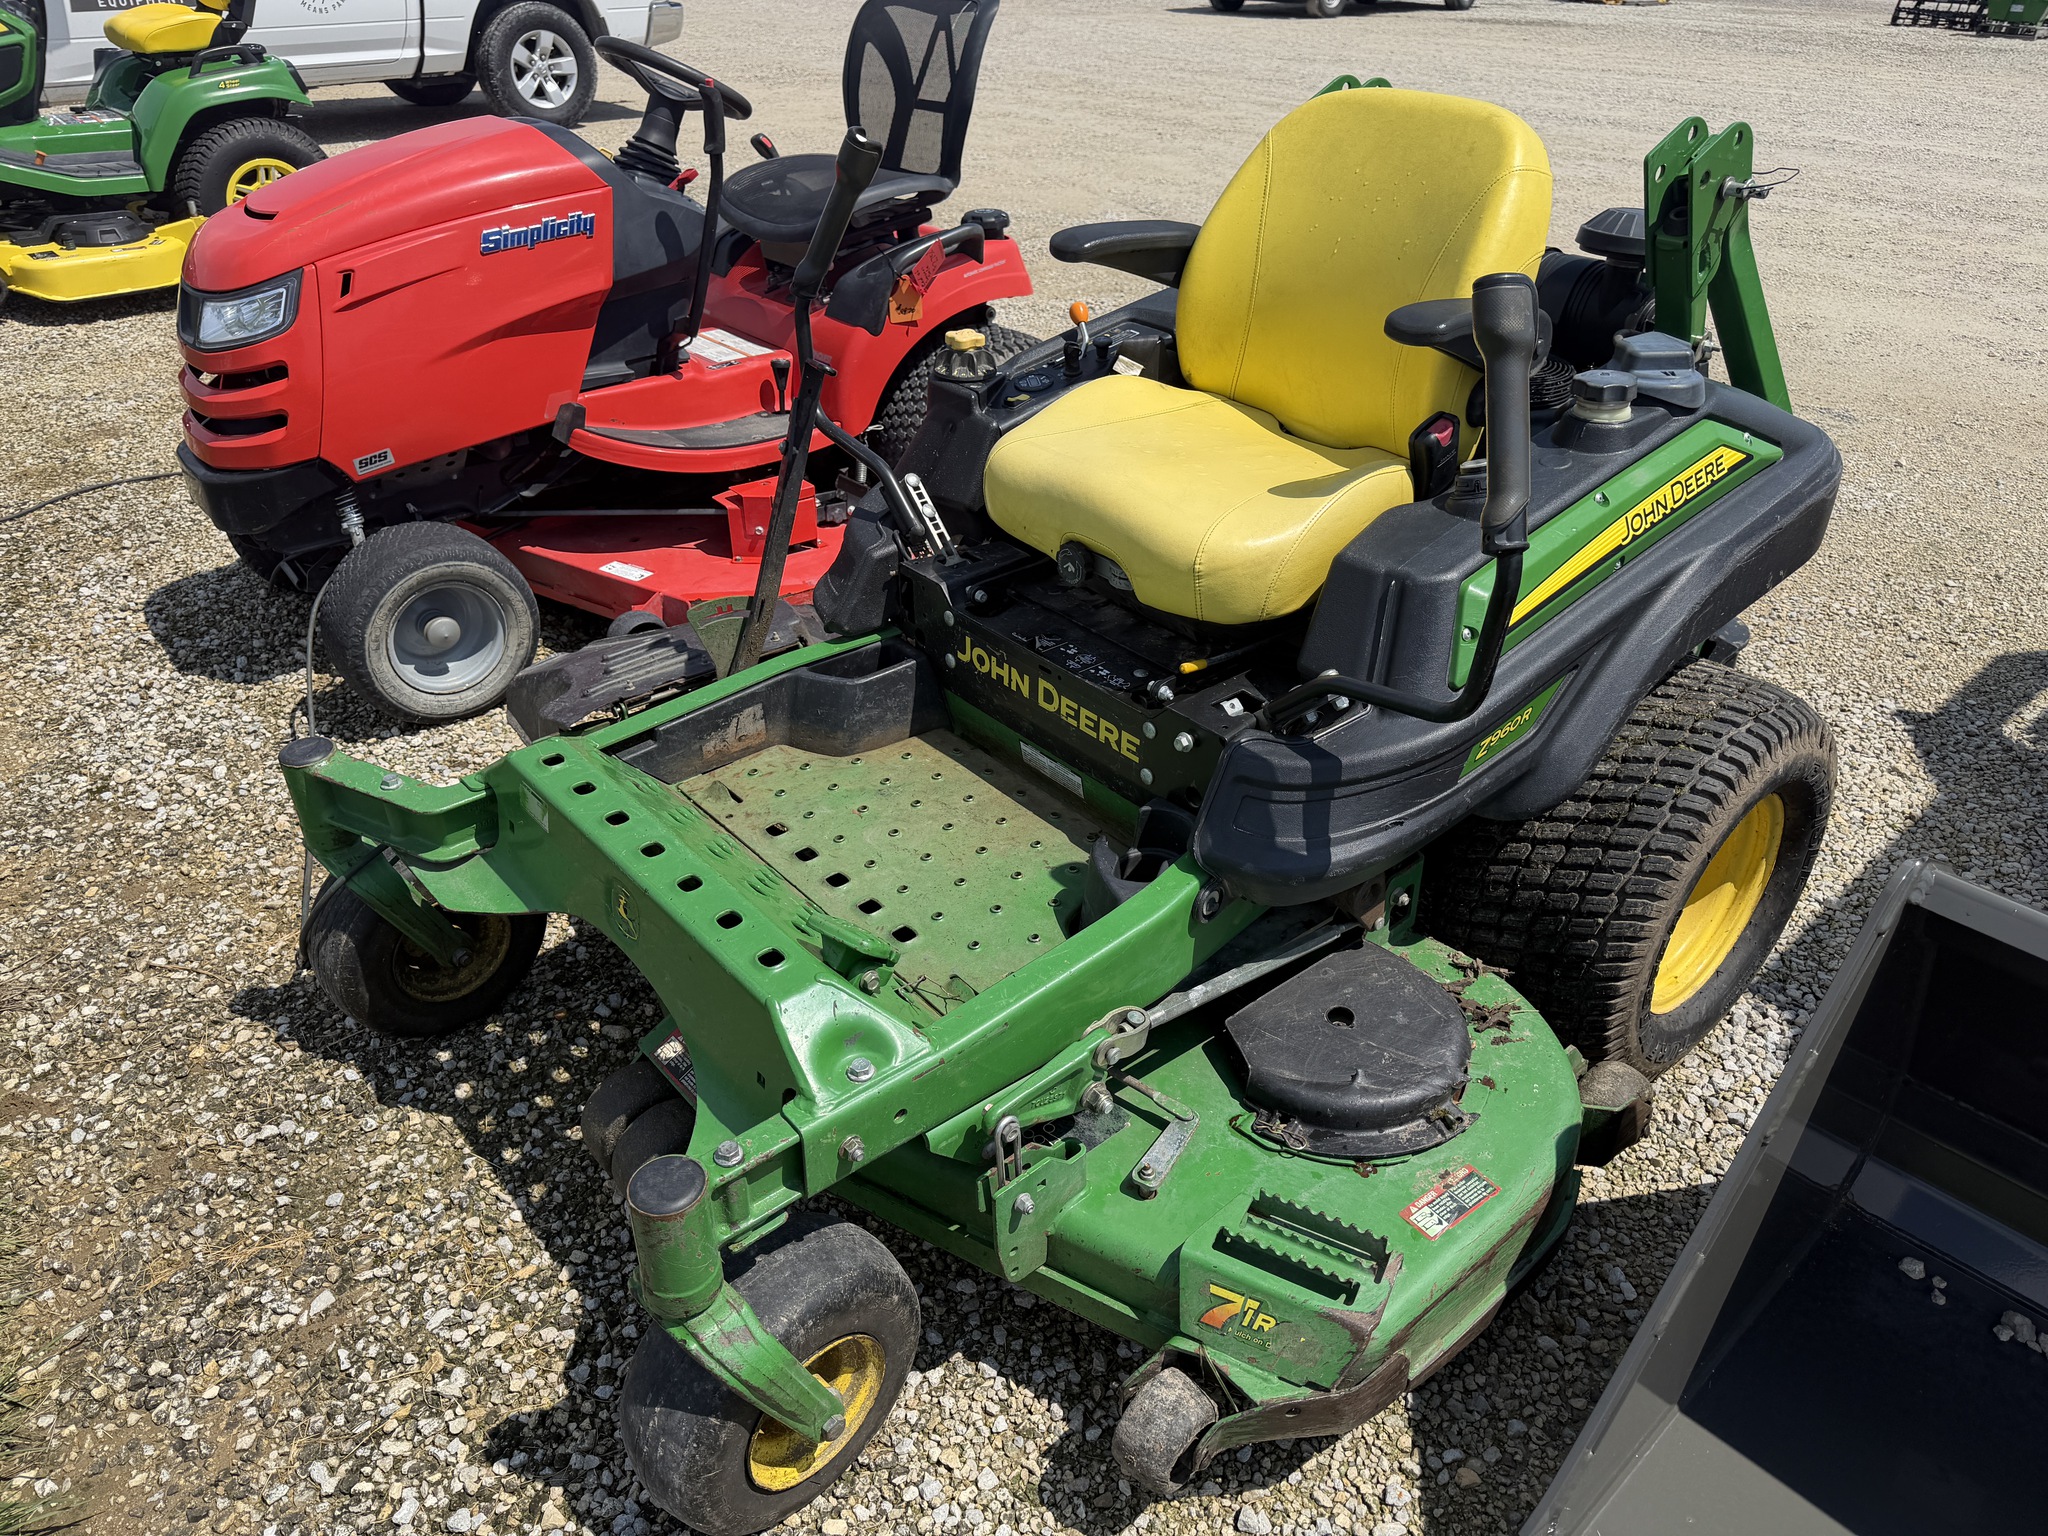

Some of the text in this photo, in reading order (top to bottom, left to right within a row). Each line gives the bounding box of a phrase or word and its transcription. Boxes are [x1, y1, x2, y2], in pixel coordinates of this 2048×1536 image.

[98, 0, 184, 8] EQUIP
[300, 0, 329, 14] MEANS
[218, 80, 226, 89] 4
[480, 211, 595, 255] Simplicity
[358, 451, 388, 469] SCS
[1621, 454, 1726, 543] JOHN DEERE
[957, 635, 1030, 699] JOHN
[1038, 677, 1141, 764] DEERE
[1475, 706, 1532, 761] Z960R
[1414, 1190, 1438, 1209] DANGER
